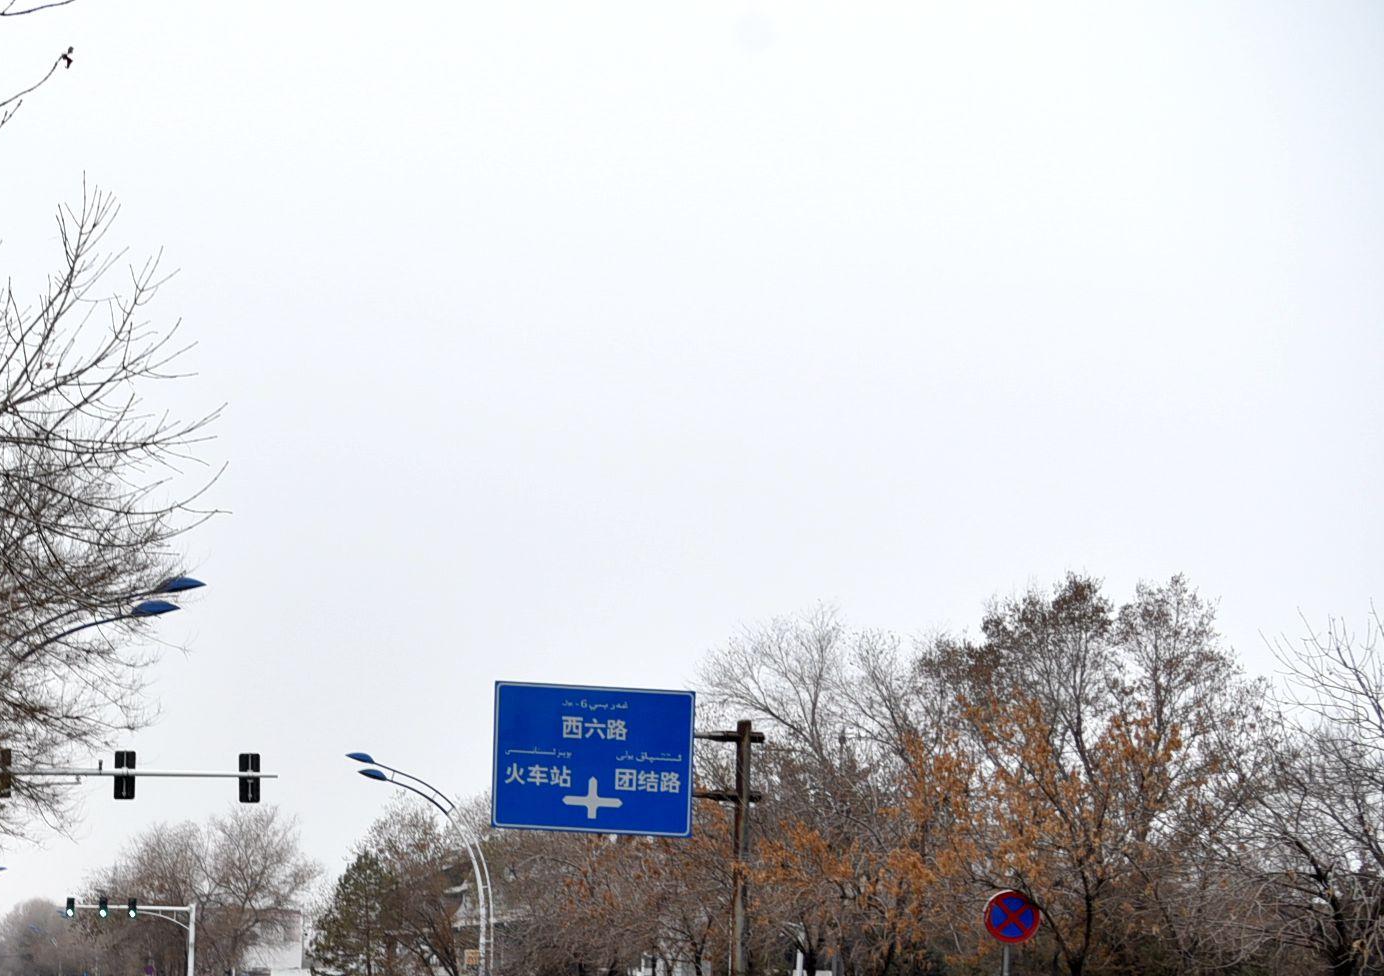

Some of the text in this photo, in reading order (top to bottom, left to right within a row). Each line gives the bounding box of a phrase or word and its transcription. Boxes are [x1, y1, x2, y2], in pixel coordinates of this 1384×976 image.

[562, 716, 628, 740] 西六路
[505, 763, 572, 787] 火车站
[615, 768, 681, 793] 团结路
